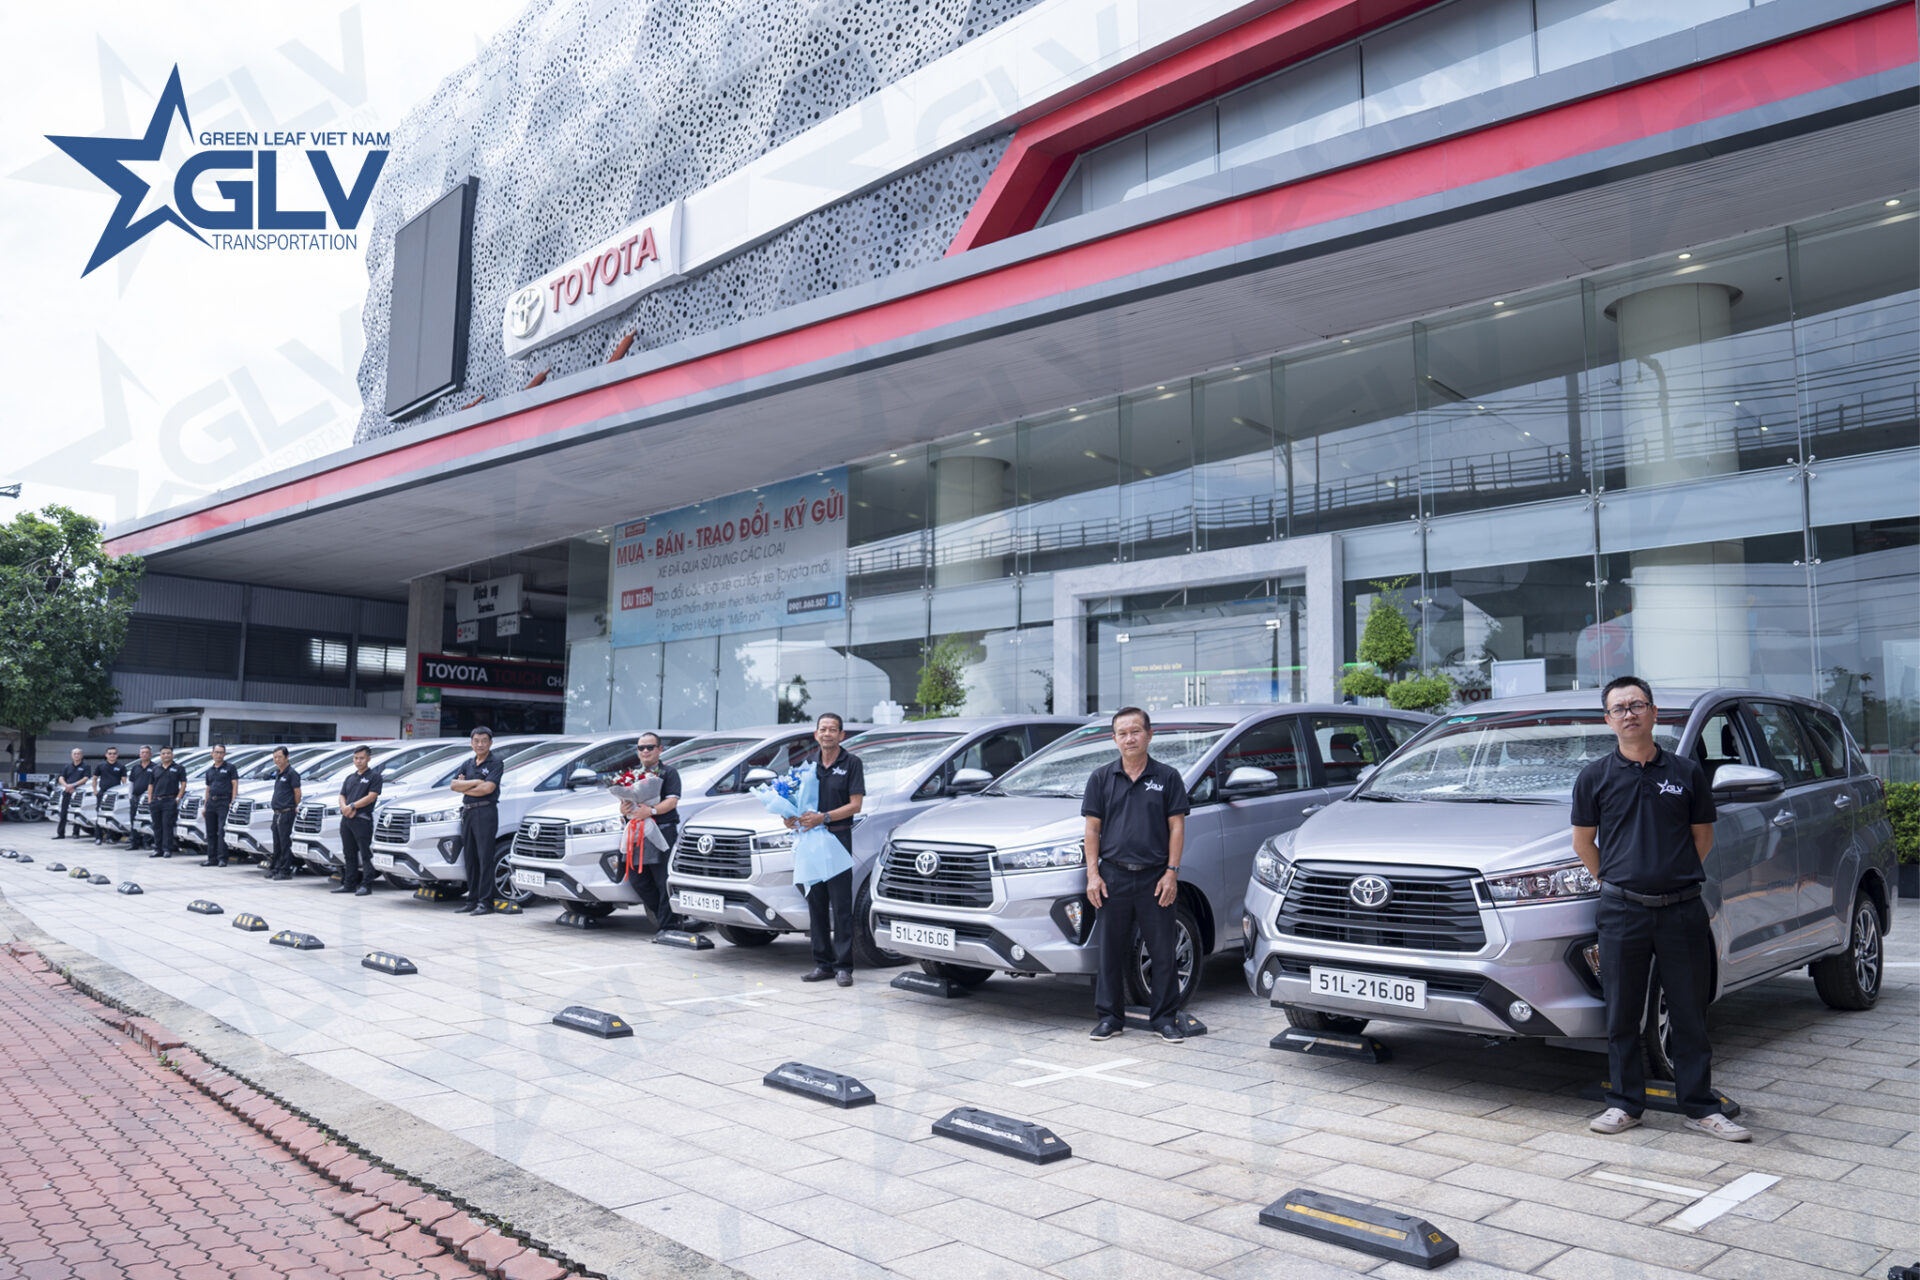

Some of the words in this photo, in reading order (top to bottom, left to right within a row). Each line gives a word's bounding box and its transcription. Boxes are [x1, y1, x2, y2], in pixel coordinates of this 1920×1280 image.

[549, 226, 658, 313] TOYOTA
[616, 541, 645, 567] MUA
[656, 529, 685, 557] BÁN
[696, 521, 735, 548] TRAO
[739, 502, 769, 538] ĐỔI
[784, 497, 806, 529] KÝ
[811, 488, 844, 522] GỬI
[682, 558, 699, 574] QUA
[740, 545, 762, 562] CÁC
[635, 589, 652, 605] TIÊN
[777, 565, 810, 583] Toyota
[426, 662, 488, 682] TOYOTA
[494, 668, 542, 685] TOUCH
[682, 894, 720, 910] 51L-419.18
[896, 926, 949, 946] 51L-216.06
[1320, 973, 1415, 1003] 51L-216.08
